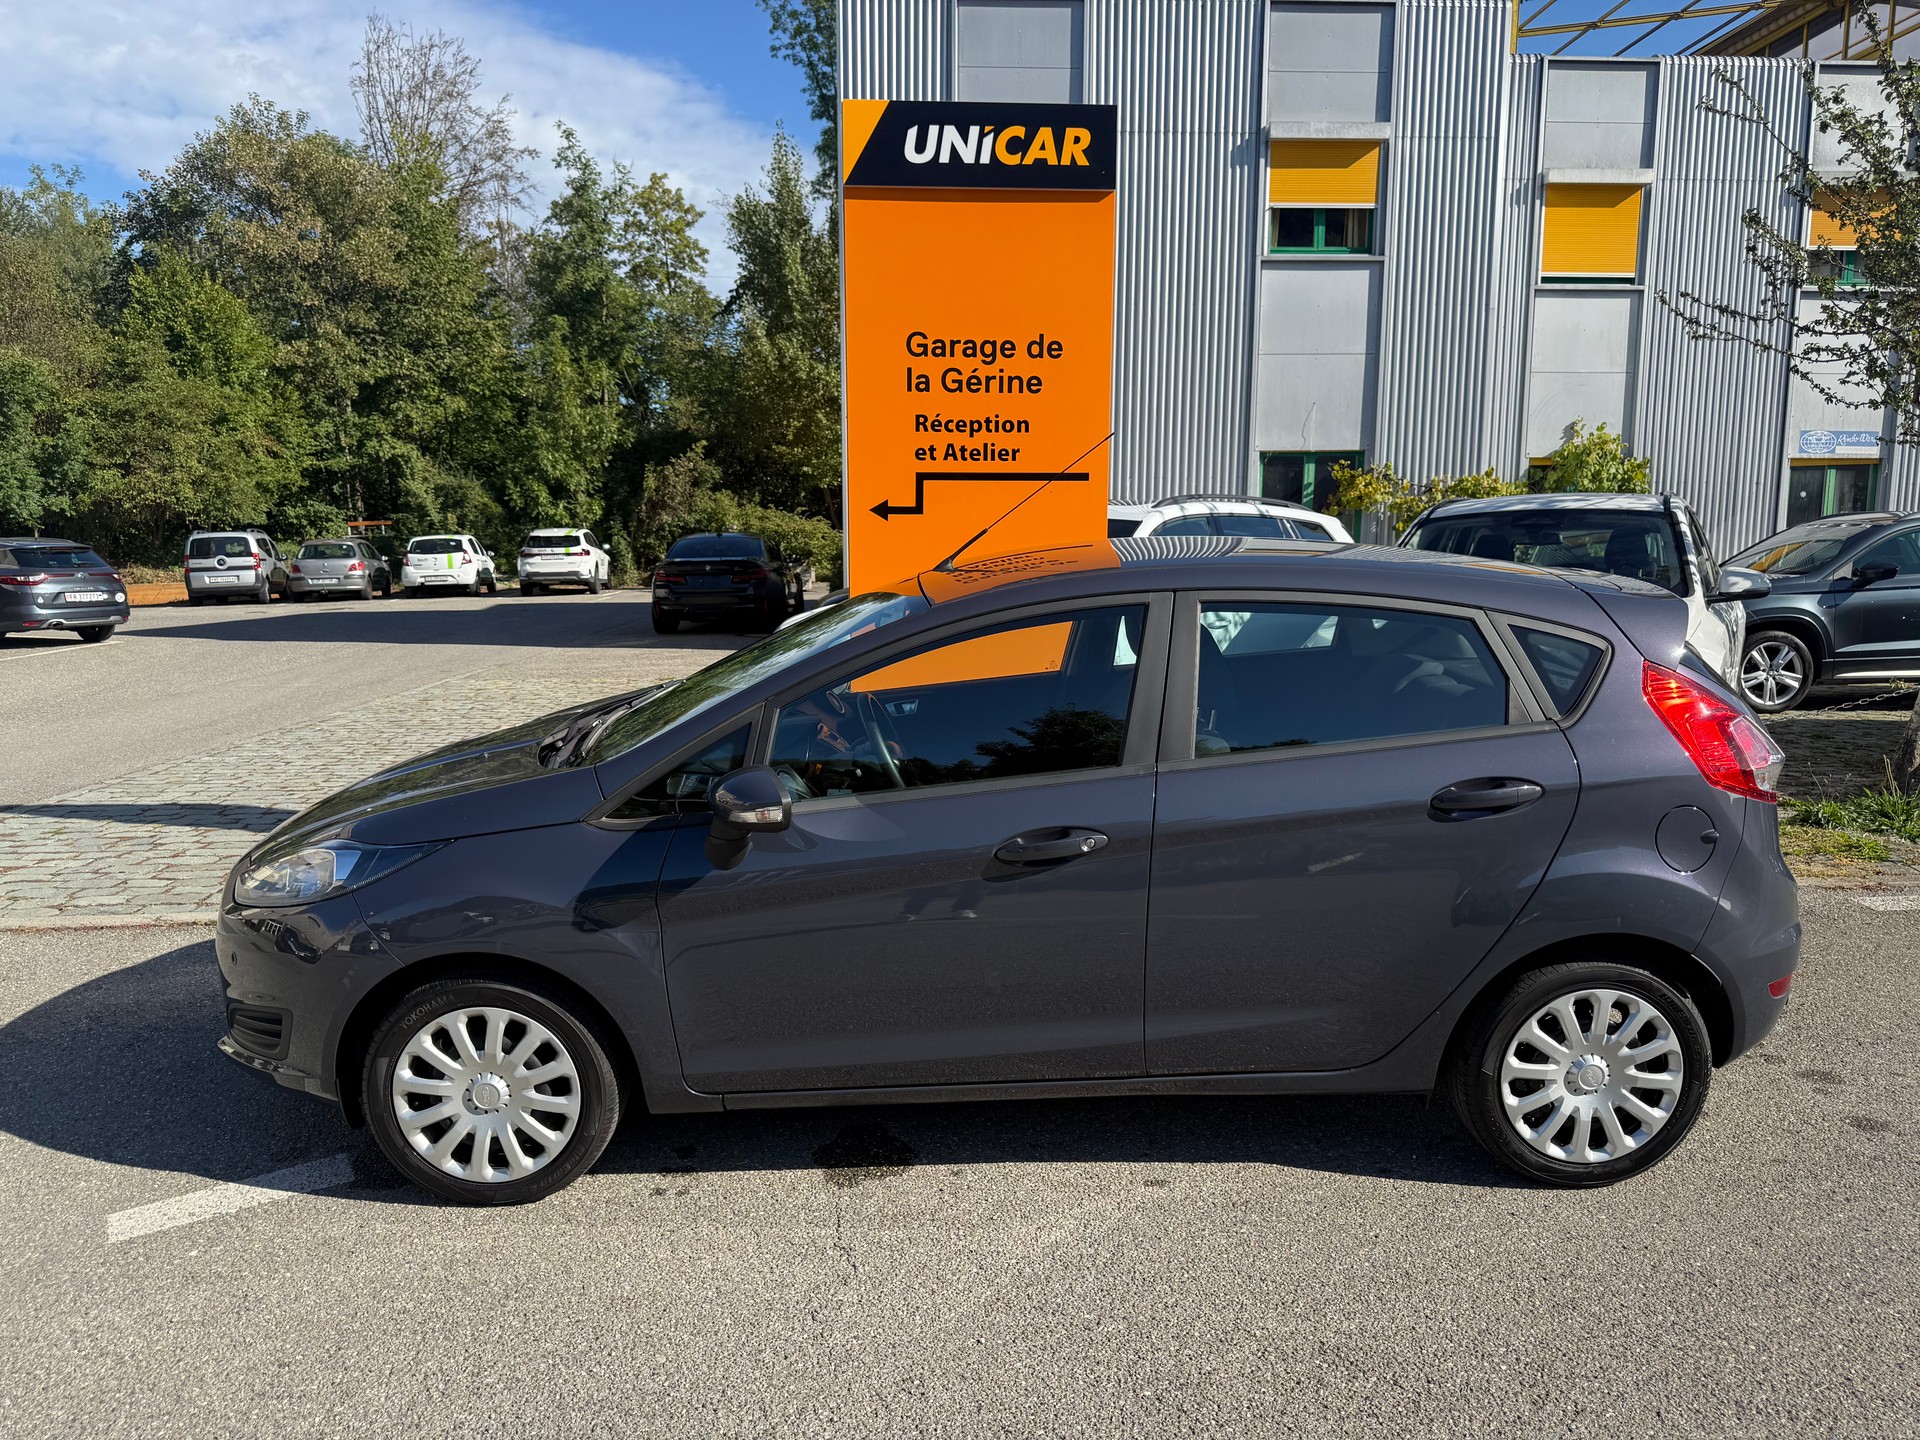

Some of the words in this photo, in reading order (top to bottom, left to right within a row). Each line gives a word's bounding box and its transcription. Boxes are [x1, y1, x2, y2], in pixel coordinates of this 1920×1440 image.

[906, 331, 1017, 366] Garage
[1026, 333, 1064, 359] de
[906, 367, 931, 393] la
[941, 367, 1043, 394] Gérine
[915, 413, 1030, 438] Réception
[914, 444, 937, 461] et
[943, 442, 1021, 462] Atelier
[399, 993, 457, 1030] YOKOHAMA
